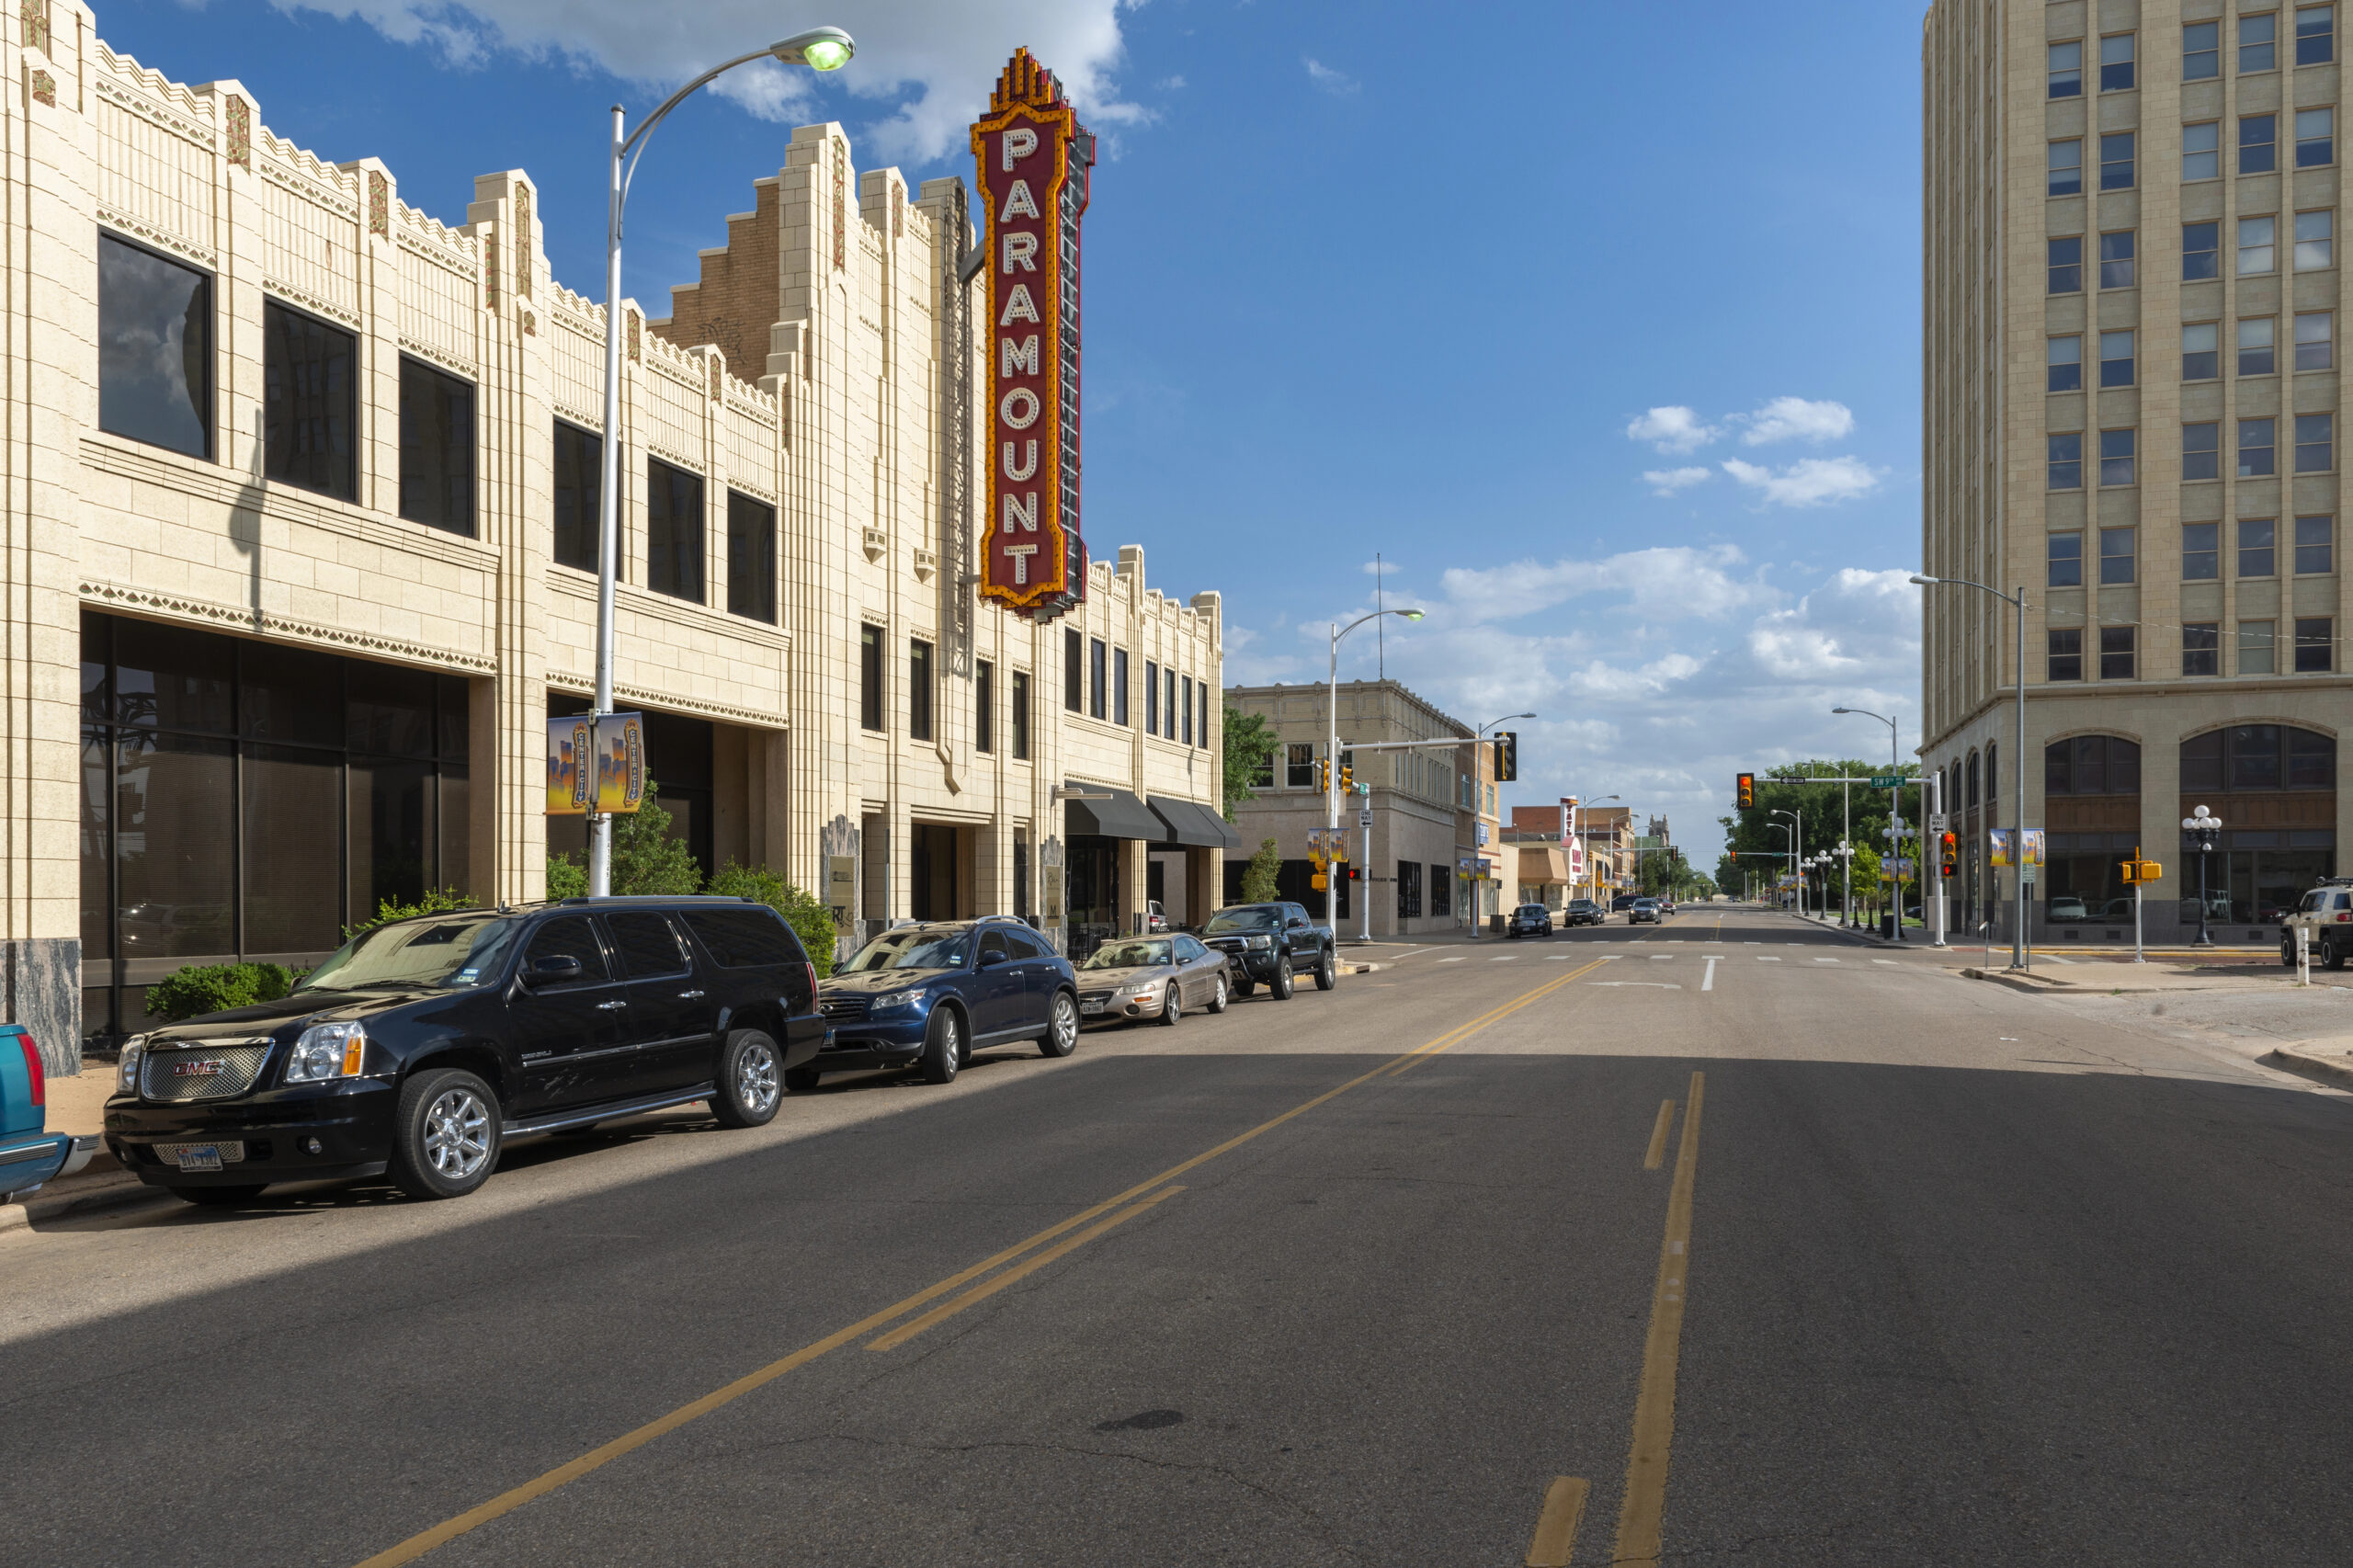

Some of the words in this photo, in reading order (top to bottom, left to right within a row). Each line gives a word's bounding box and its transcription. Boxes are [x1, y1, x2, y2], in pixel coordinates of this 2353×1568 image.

[1000, 128, 1040, 585] PARAMOUNT
[630, 730, 638, 768] CENTER
[630, 774, 638, 800] CITY
[175, 1060, 226, 1075] GMC
